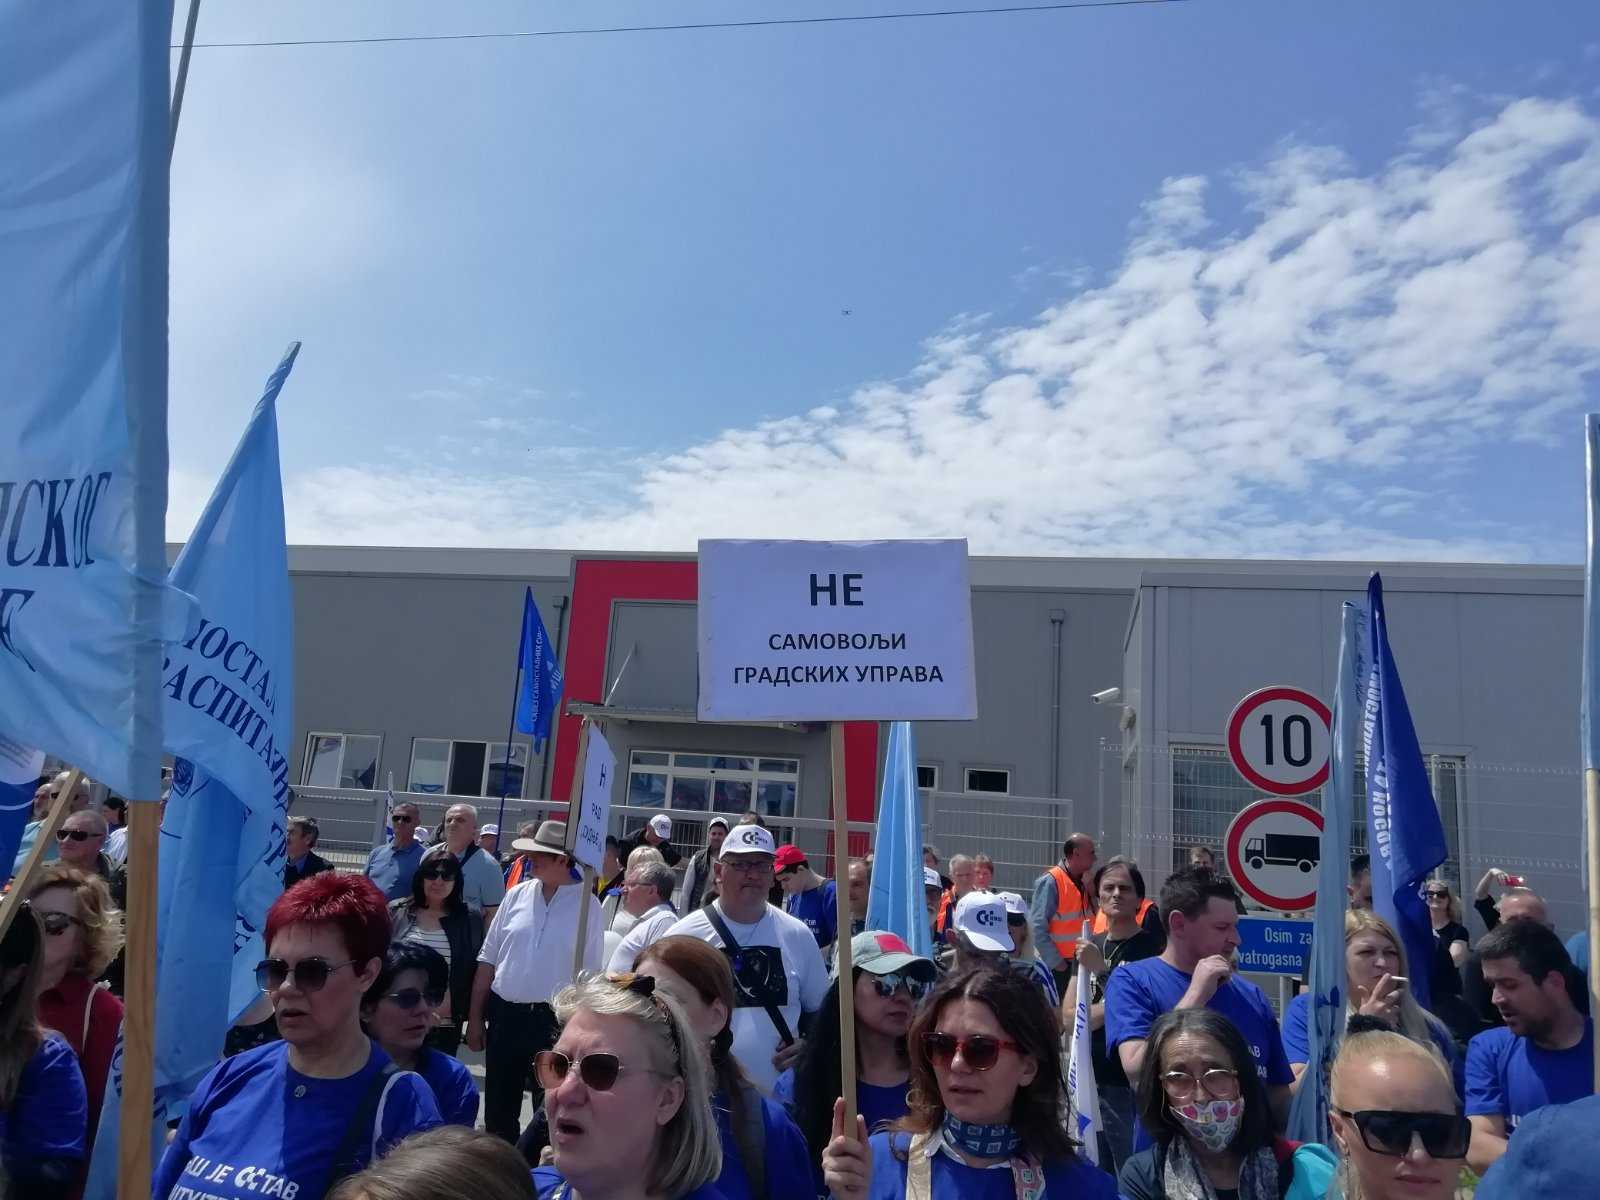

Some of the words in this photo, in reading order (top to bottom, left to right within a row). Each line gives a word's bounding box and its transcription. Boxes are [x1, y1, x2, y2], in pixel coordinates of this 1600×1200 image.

[809, 573, 864, 606] НЕ
[768, 633, 906, 651] САМОВОЉИ
[733, 666, 849, 687] ГРАДСКИХ
[855, 665, 944, 683] УПРАВА
[1260, 714, 1312, 767] 10
[1264, 927, 1292, 943] Osim
[1299, 932, 1313, 945] za
[1239, 949, 1302, 969] vatrogasna
